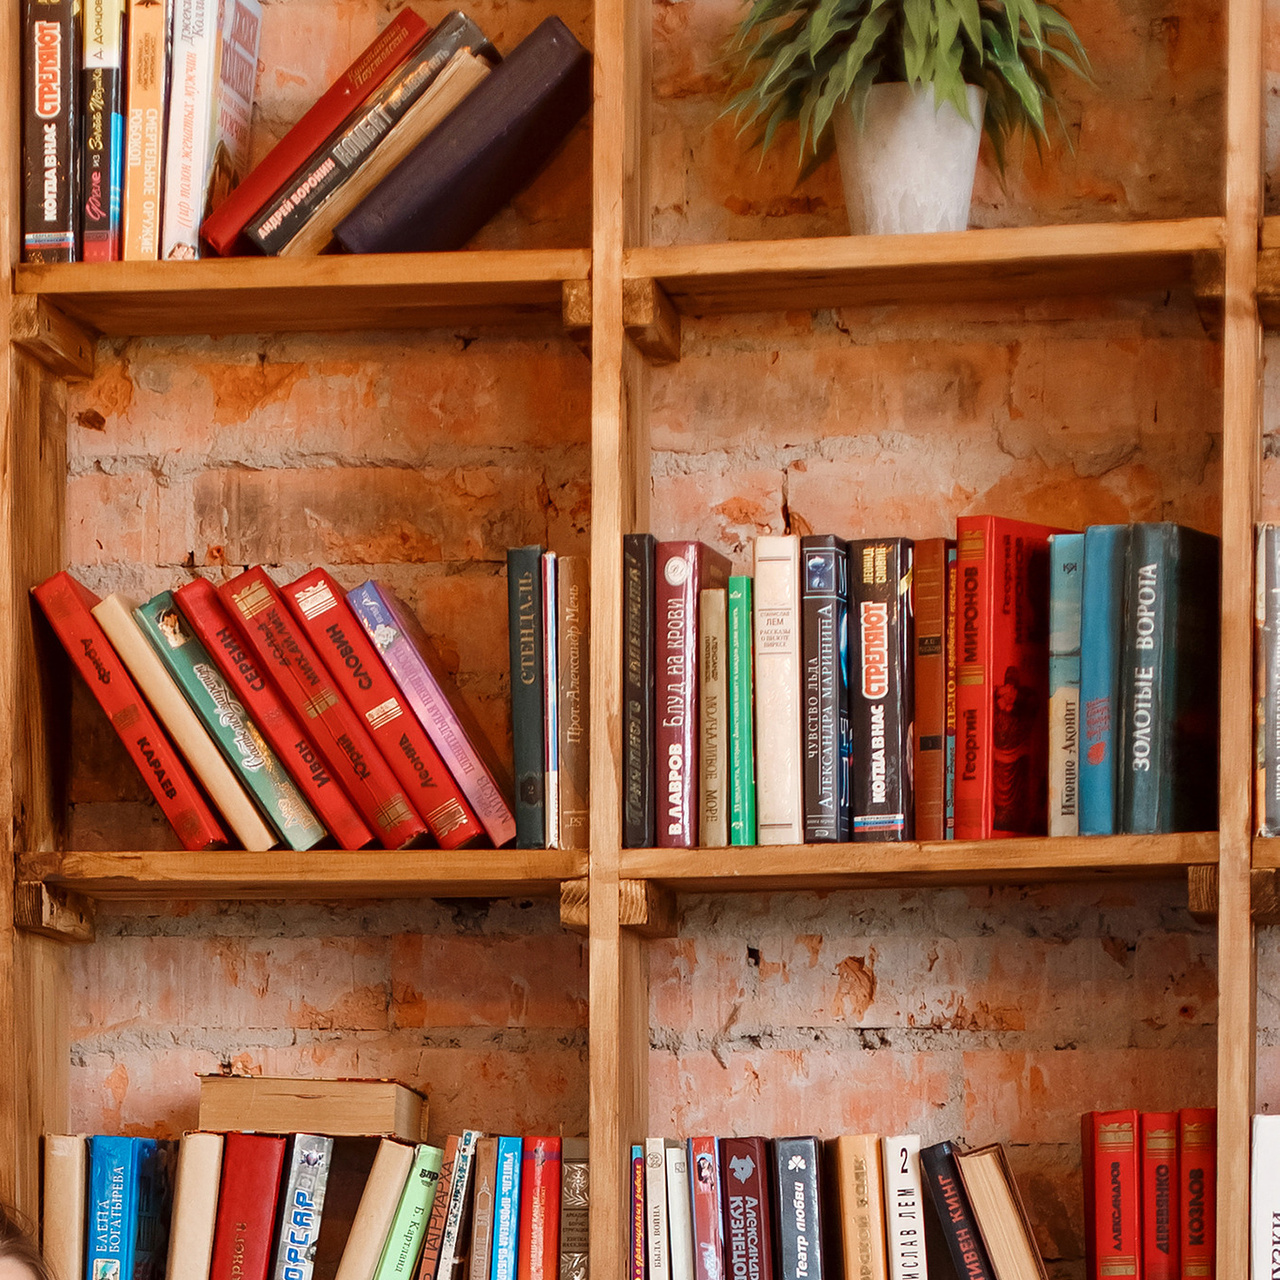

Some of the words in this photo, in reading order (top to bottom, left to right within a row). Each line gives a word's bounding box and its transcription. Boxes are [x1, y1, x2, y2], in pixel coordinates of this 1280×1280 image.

[35, 20, 61, 118] СТРЕЛЯЮТ
[129, 108, 141, 166] РОБОКОП
[146, 108, 158, 195] СМЕРТЕЛЬНОЕ
[141, 201, 154, 253] ОРУЖИЕ
[258, 198, 295, 239] АНДРЕЙ
[291, 158, 336, 206] ВОРОНИН
[863, 548, 875, 583] ЛЕОНИД
[519, 571, 535, 684] СТЕНДАЛЬ
[665, 598, 684, 648] крови
[964, 567, 979, 662] МИРОНОВ
[1136, 563, 1157, 649] ВОРОТА
[216, 626, 266, 692] СЕРБИН
[325, 622, 373, 690] СЛОВИН
[667, 656, 681, 675] на
[808, 657, 819, 691] ЛЬДА
[860, 602, 888, 699] СТРЕЛЯЮТ
[663, 682, 686, 726] Блуд
[808, 696, 818, 758] ЧУВСТВО
[1132, 667, 1154, 771] ЗОЛОТЫЕ
[294, 739, 332, 788] Иван
[399, 732, 437, 788] Леонид
[705, 696, 717, 779] МОЛЧАЛИВОЕ
[961, 709, 977, 781] Георгий
[667, 743, 683, 835] В.ЛАВРОВ
[706, 790, 718, 822] МОРЕ
[900, 1147, 909, 1173] 2
[96, 1200, 110, 1252] ЕЛЕНА
[109, 1166, 124, 1253] БОГАТЫРЕВА
[424, 1161, 454, 1260] ПАТРИАРХА
[653, 1205, 661, 1236] ВОЙНА
[794, 1182, 807, 1231] любви
[897, 1188, 916, 1220] ЛЕМ
[938, 1174, 965, 1221] КИНГ
[746, 1196, 759, 1280] АЛЕКСАНДР
[795, 1235, 809, 1278] Театр
